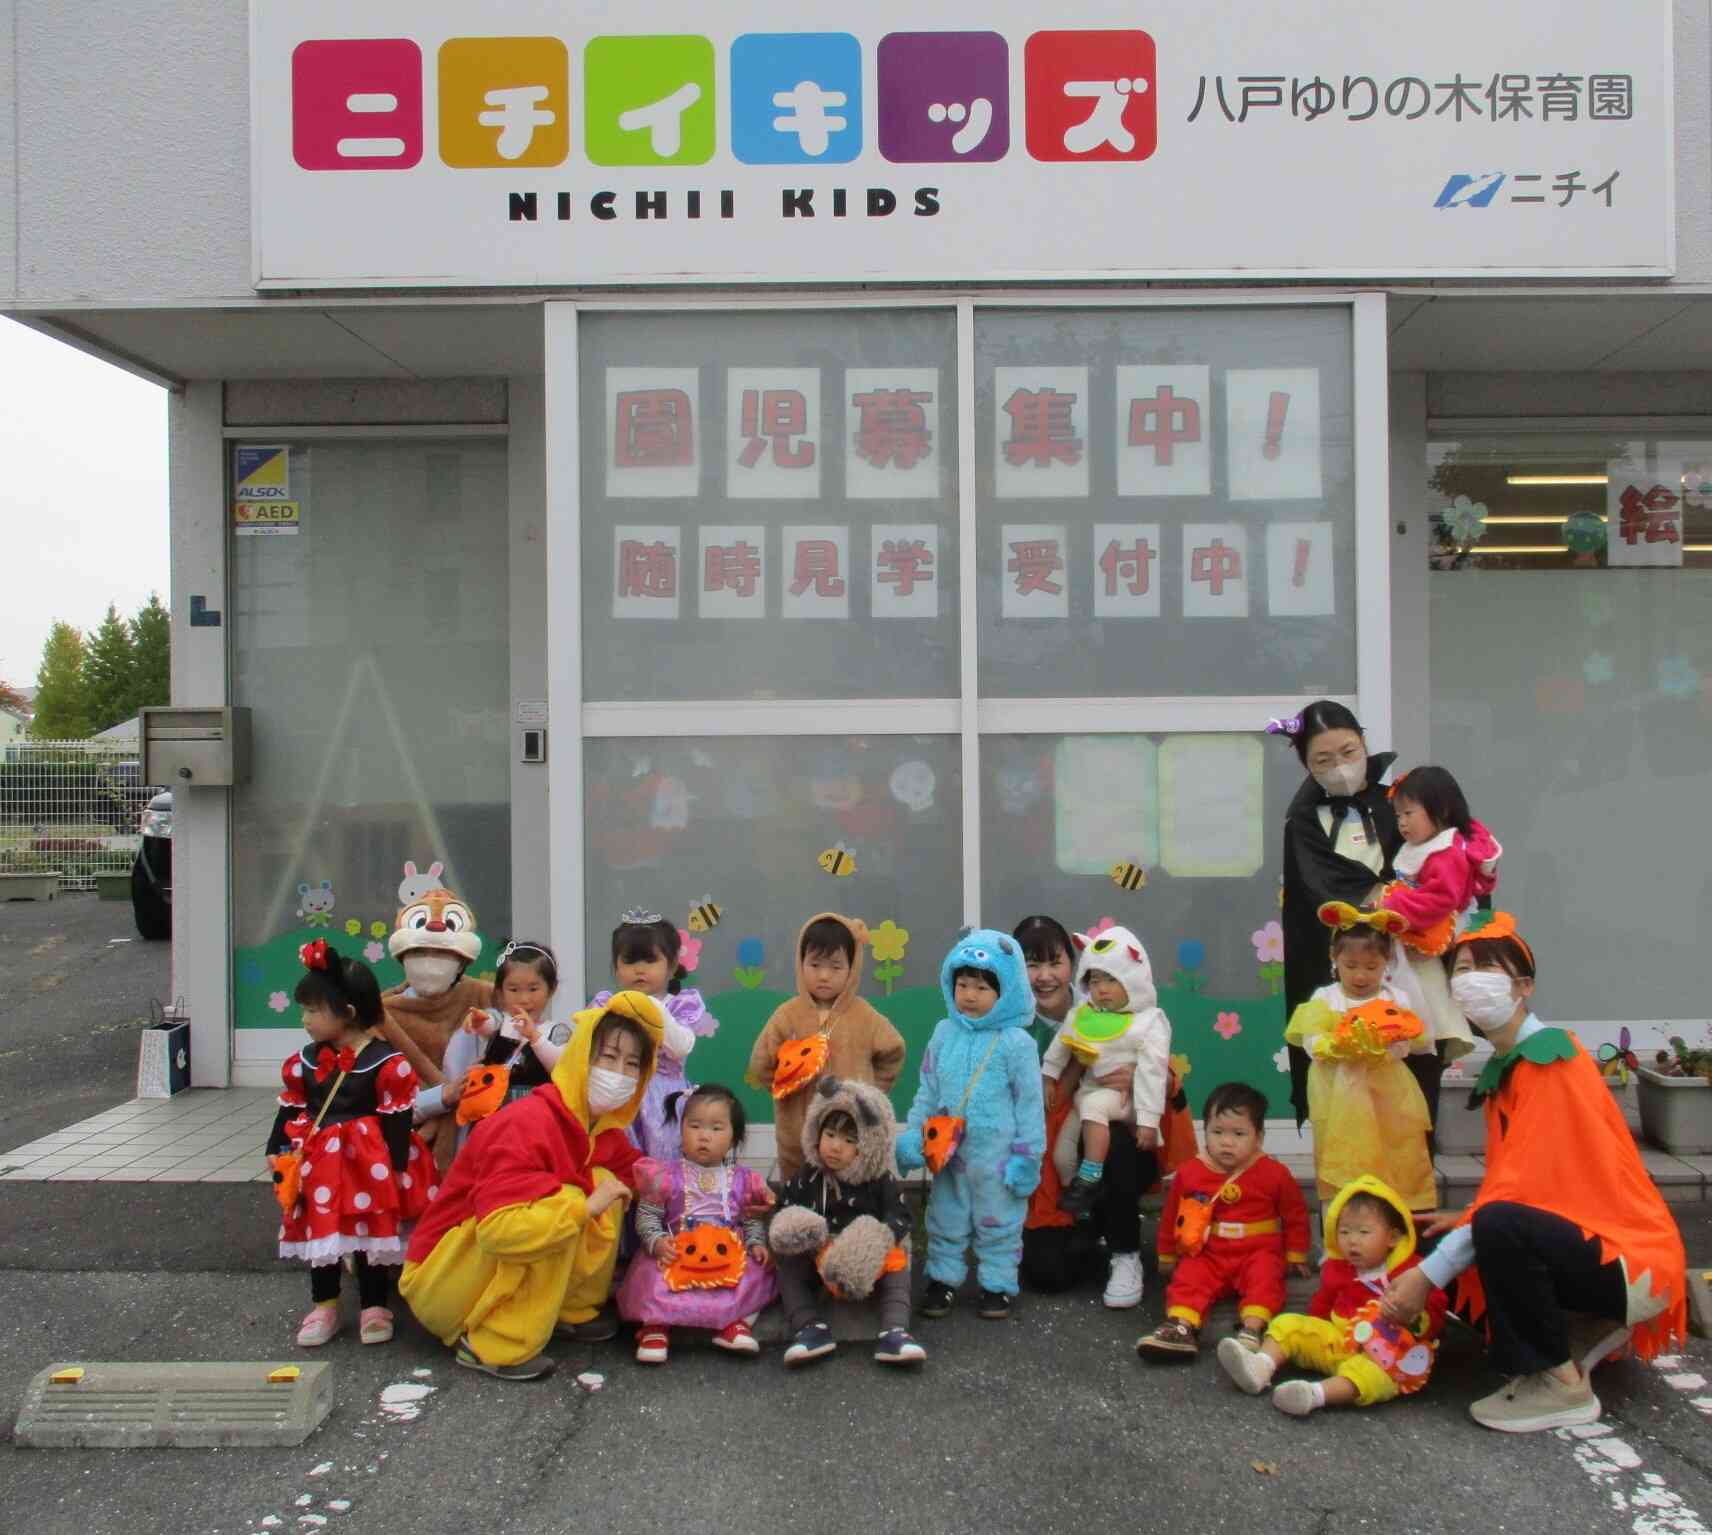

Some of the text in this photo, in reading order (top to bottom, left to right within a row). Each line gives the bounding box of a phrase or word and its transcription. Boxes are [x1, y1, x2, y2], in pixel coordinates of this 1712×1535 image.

[1186, 73, 1634, 124] 八戸ゆりの木保育園
[508, 187, 942, 221] NICHII KIDS
[1509, 169, 1622, 209] ニチイ
[255, 505, 294, 519] AED
